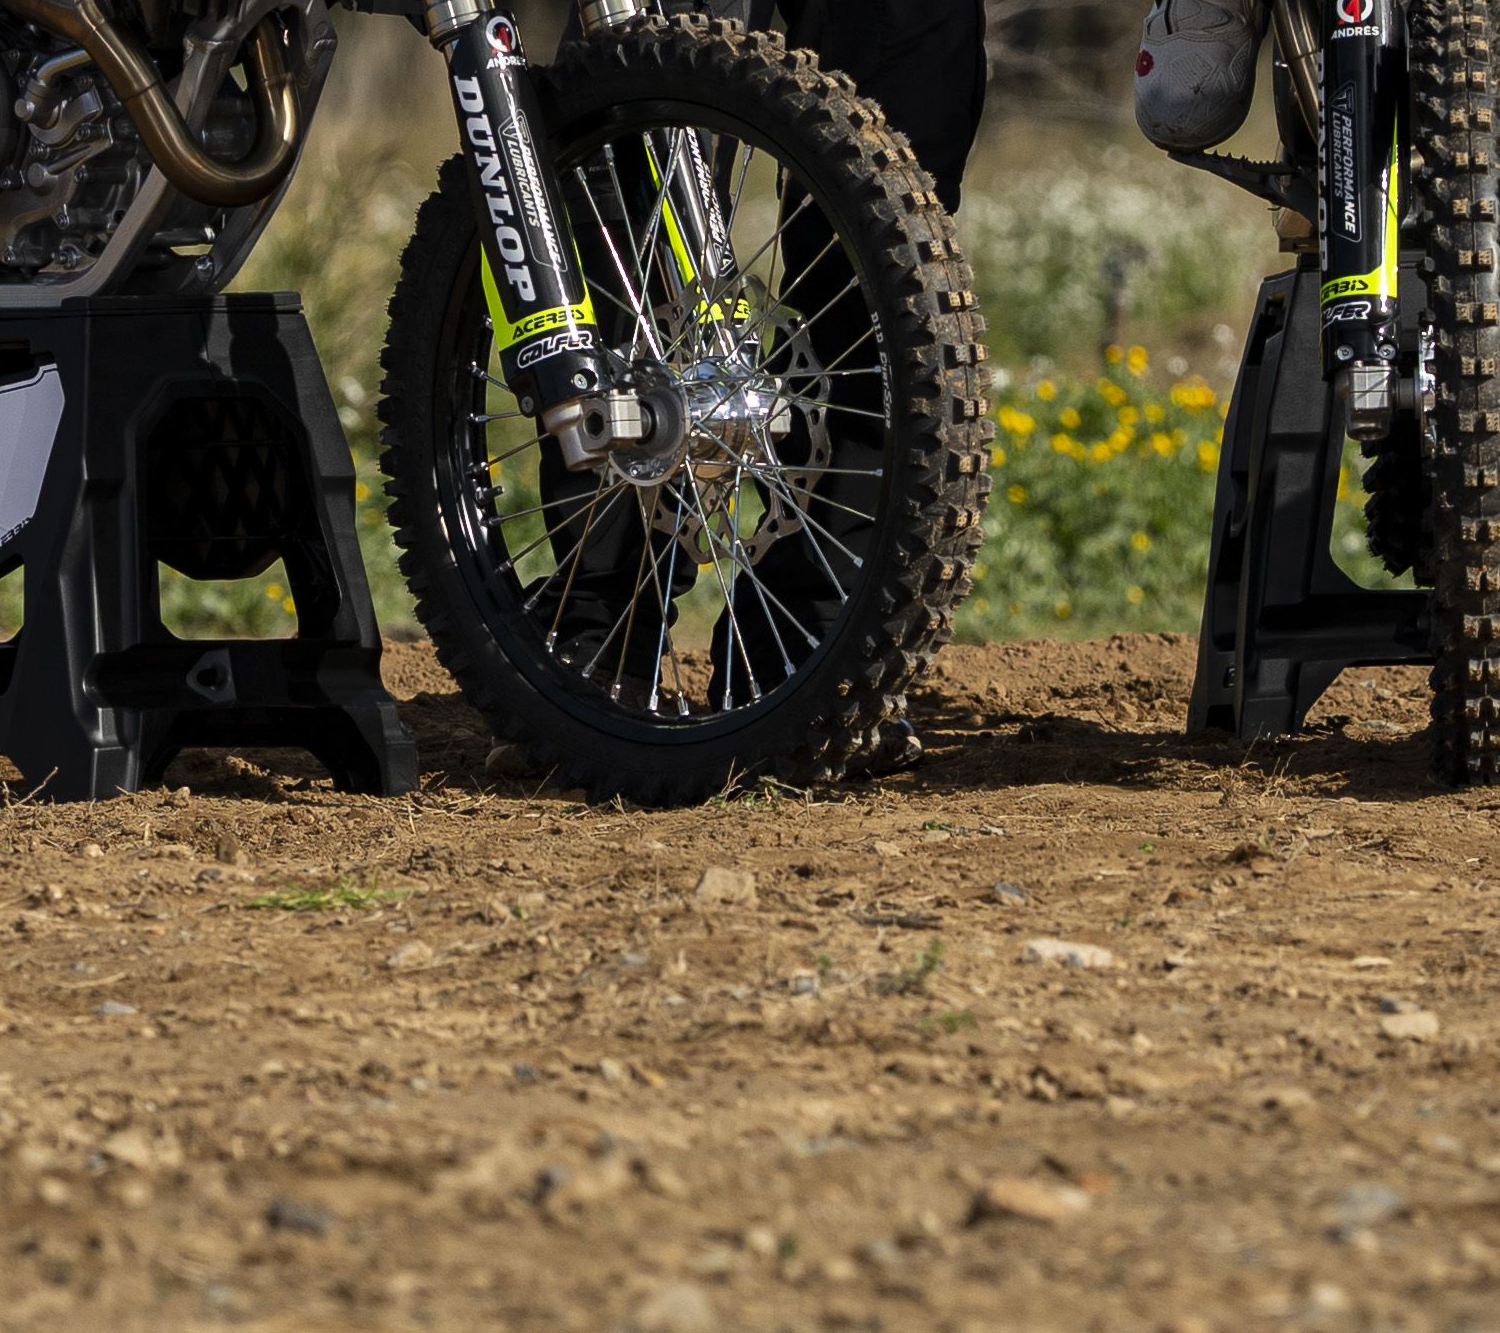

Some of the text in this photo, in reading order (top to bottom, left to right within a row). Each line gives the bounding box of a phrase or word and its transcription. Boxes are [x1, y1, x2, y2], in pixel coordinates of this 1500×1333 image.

[453, 74, 537, 301] DUNLOP
[506, 139, 540, 228] LUBRICANTS
[1332, 111, 1343, 199] LUBRICANTS
[1342, 115, 1357, 235] PERFORMANCE
